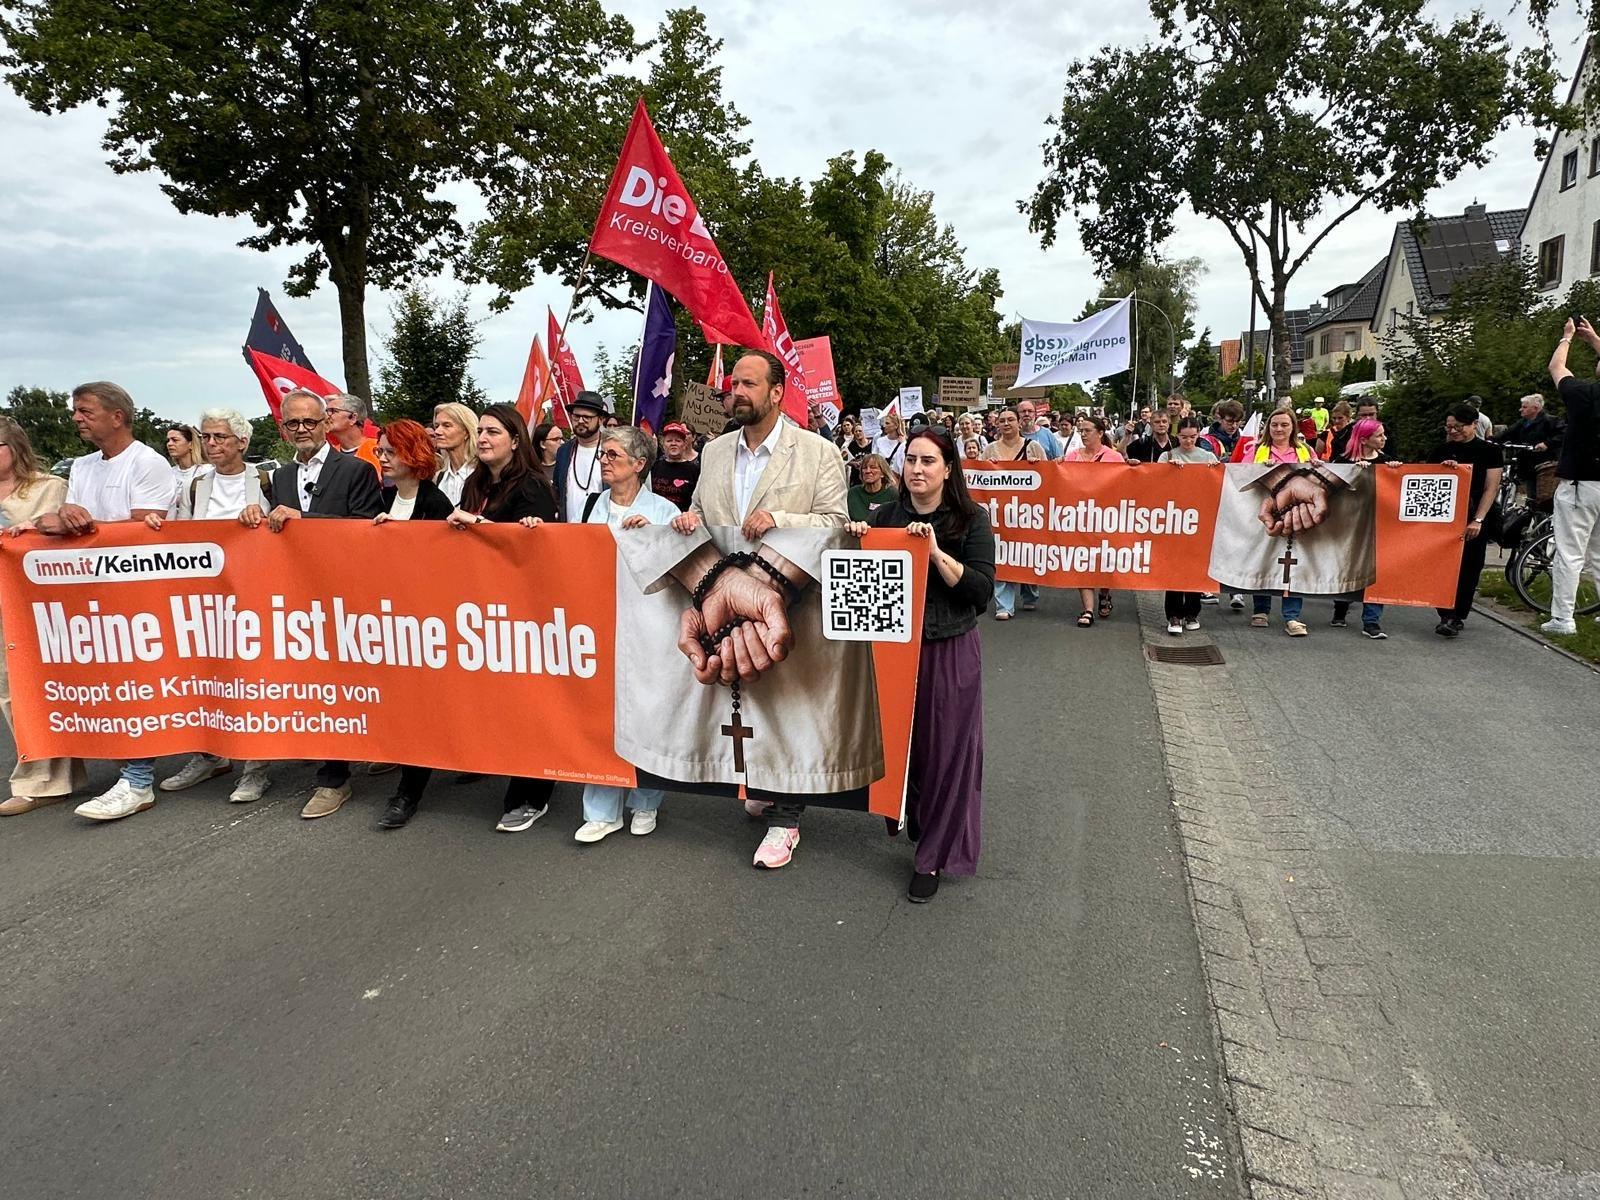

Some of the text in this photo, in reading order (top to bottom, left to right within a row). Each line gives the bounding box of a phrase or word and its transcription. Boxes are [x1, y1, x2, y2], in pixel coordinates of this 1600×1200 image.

[619, 165, 687, 225] Die
[1024, 334, 1055, 356] gbs
[686, 400, 702, 415] My
[688, 384, 705, 402] My
[963, 473, 1033, 487] it/KeinMord
[1003, 496, 1045, 530] das
[1048, 496, 1199, 535] katholische
[34, 551, 212, 577] innn.it/KeinMord
[994, 533, 1152, 577] bungsverbot!
[32, 594, 597, 679] Meine Hilfe ist keine Sünde
[43, 676, 381, 706] Stoppt die Kriminalisierung von
[48, 706, 369, 737] Schwangerschaftsabbrüchen!
